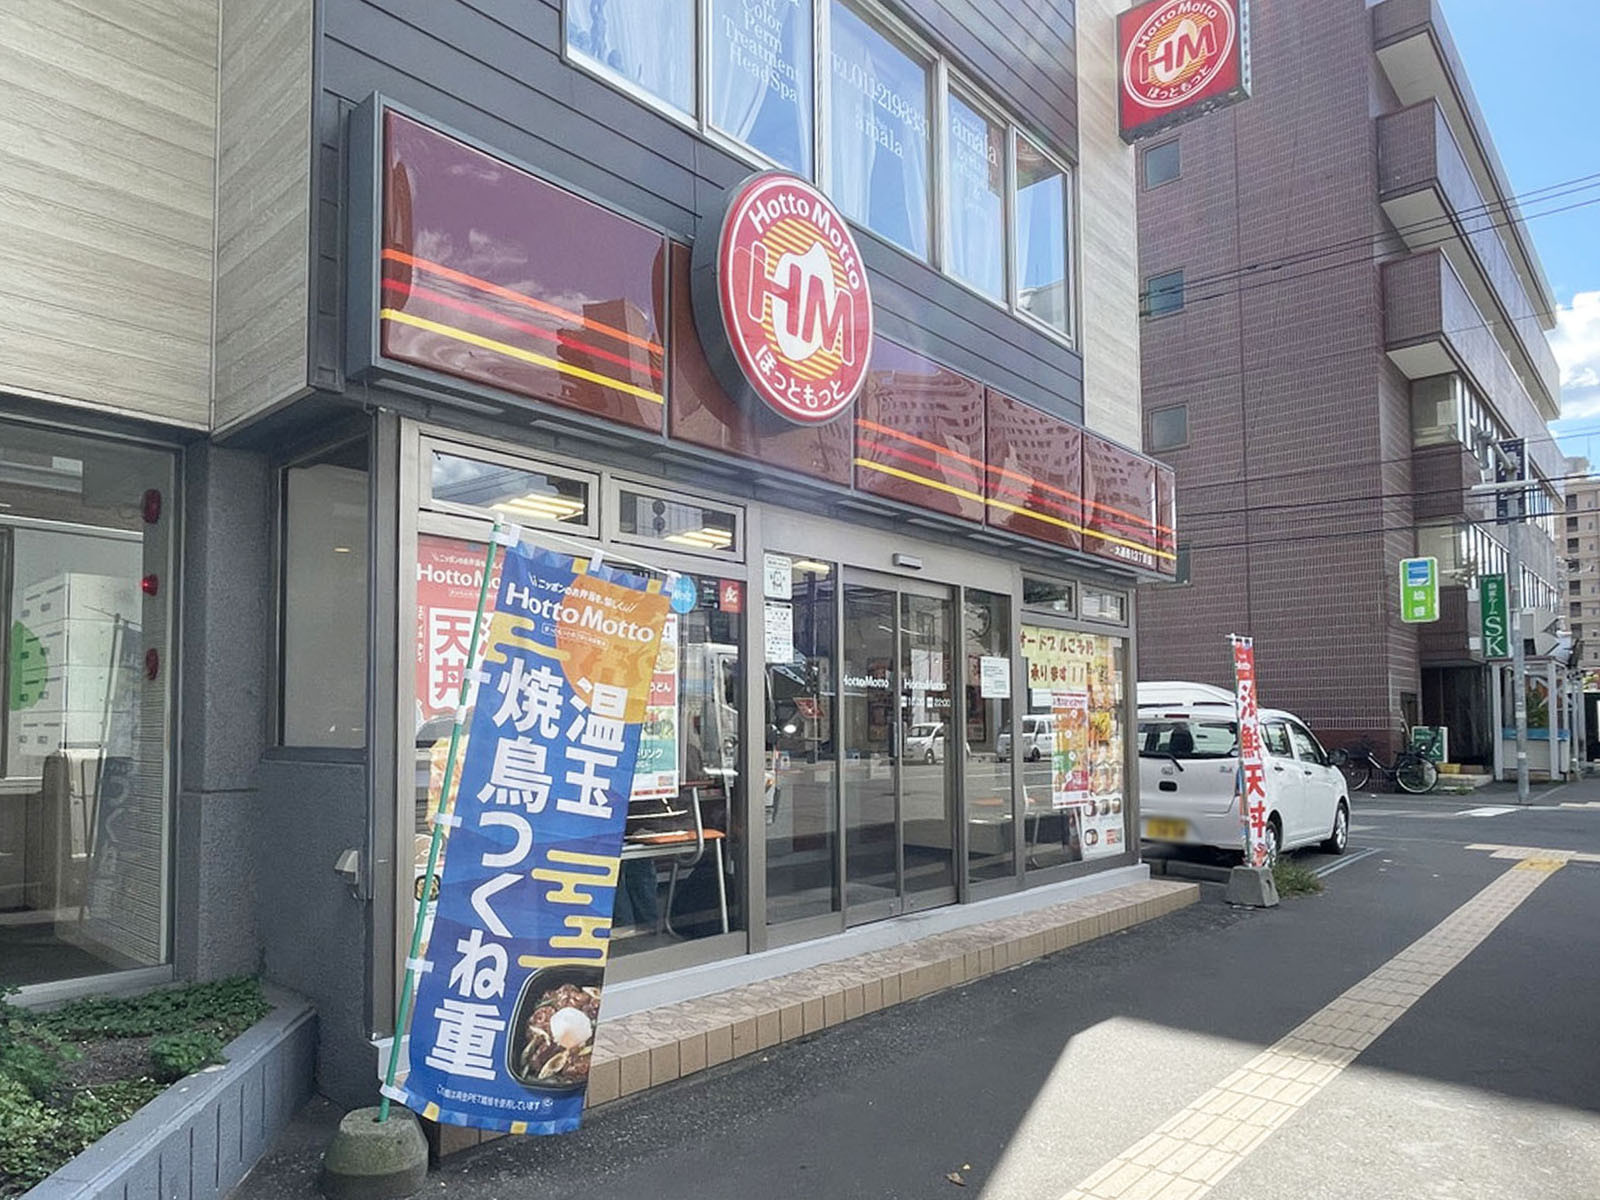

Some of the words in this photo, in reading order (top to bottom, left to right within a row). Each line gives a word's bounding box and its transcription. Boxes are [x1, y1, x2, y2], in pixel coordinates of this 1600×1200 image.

[1147, 64, 1212, 99] ほっともっと
[748, 240, 855, 367] HM
[755, 345, 846, 408] ほっともっと
[556, 676, 627, 819] 温玉
[424, 657, 564, 1081] 焼鳥つくね重
